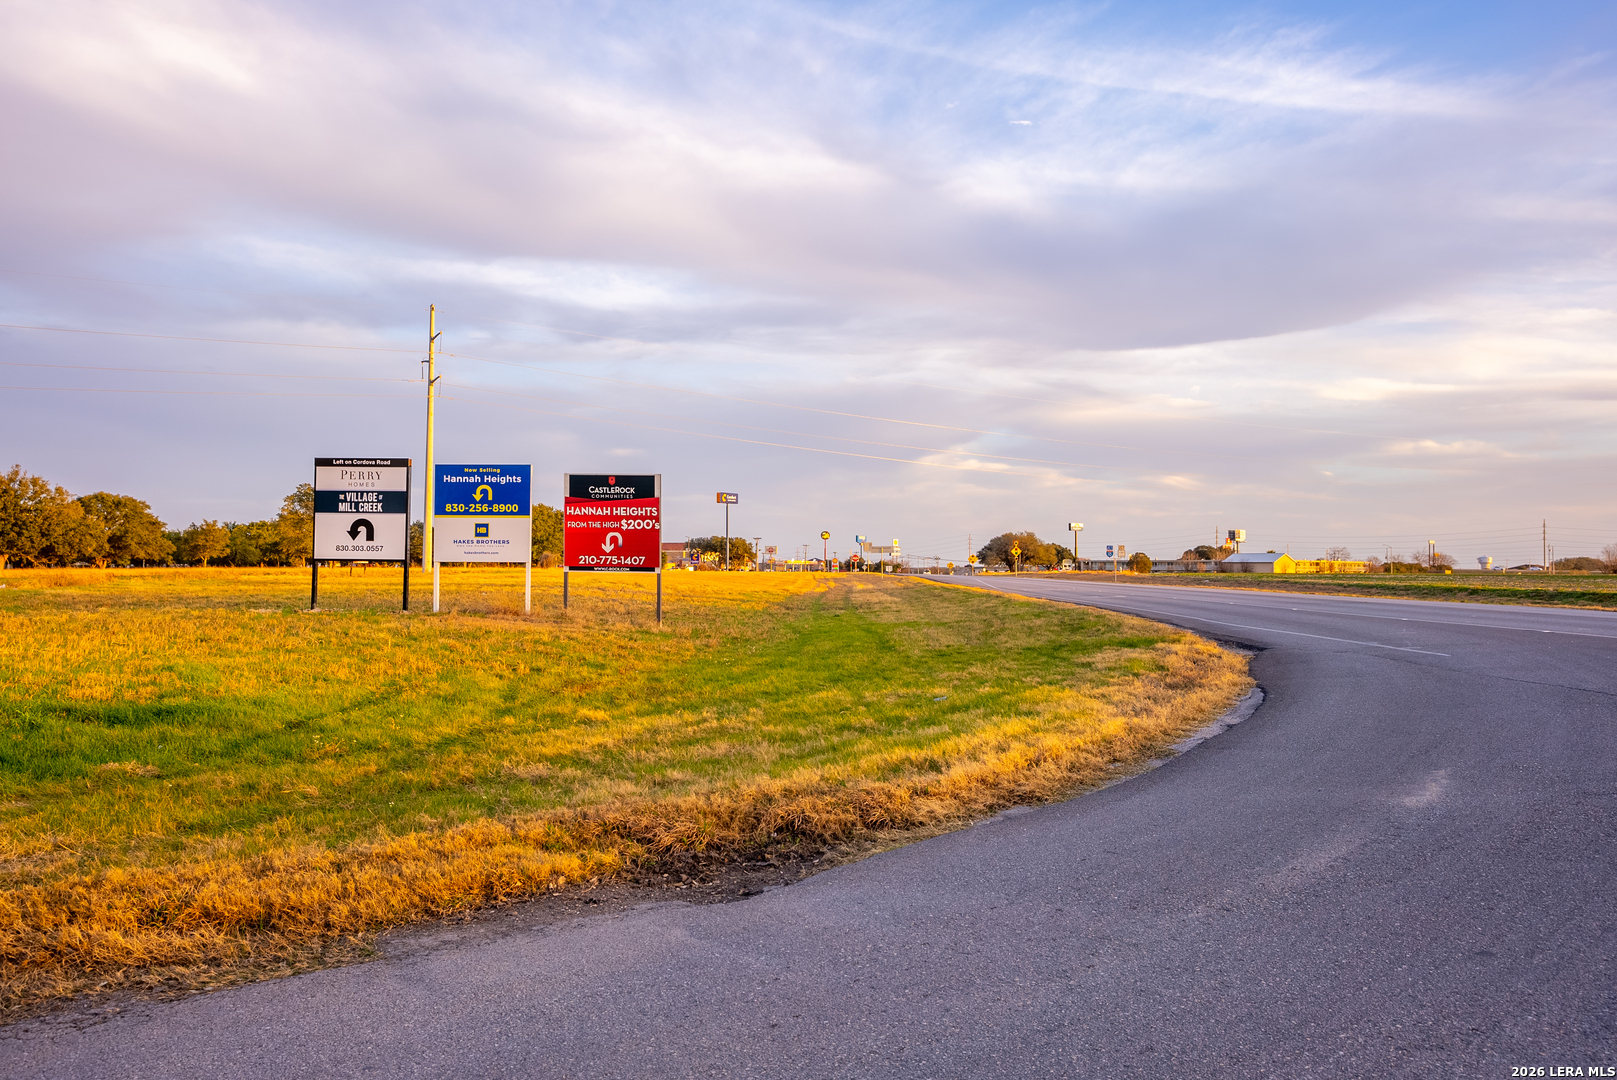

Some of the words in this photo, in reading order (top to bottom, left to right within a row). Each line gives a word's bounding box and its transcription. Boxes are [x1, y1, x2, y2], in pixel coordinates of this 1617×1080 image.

[340, 470, 383, 480] PERRY
[443, 475, 481, 483] Hannah
[484, 475, 522, 484] Heights
[346, 492, 378, 502] VILLAGE
[338, 502, 357, 512] MILL
[358, 502, 383, 512] CREEK
[445, 503, 519, 512] 830-256-8900
[566, 506, 611, 516] HANNAH
[613, 507, 658, 516] HEIGHTS
[621, 519, 660, 531] $200's
[578, 555, 646, 565] 210-775-1407
